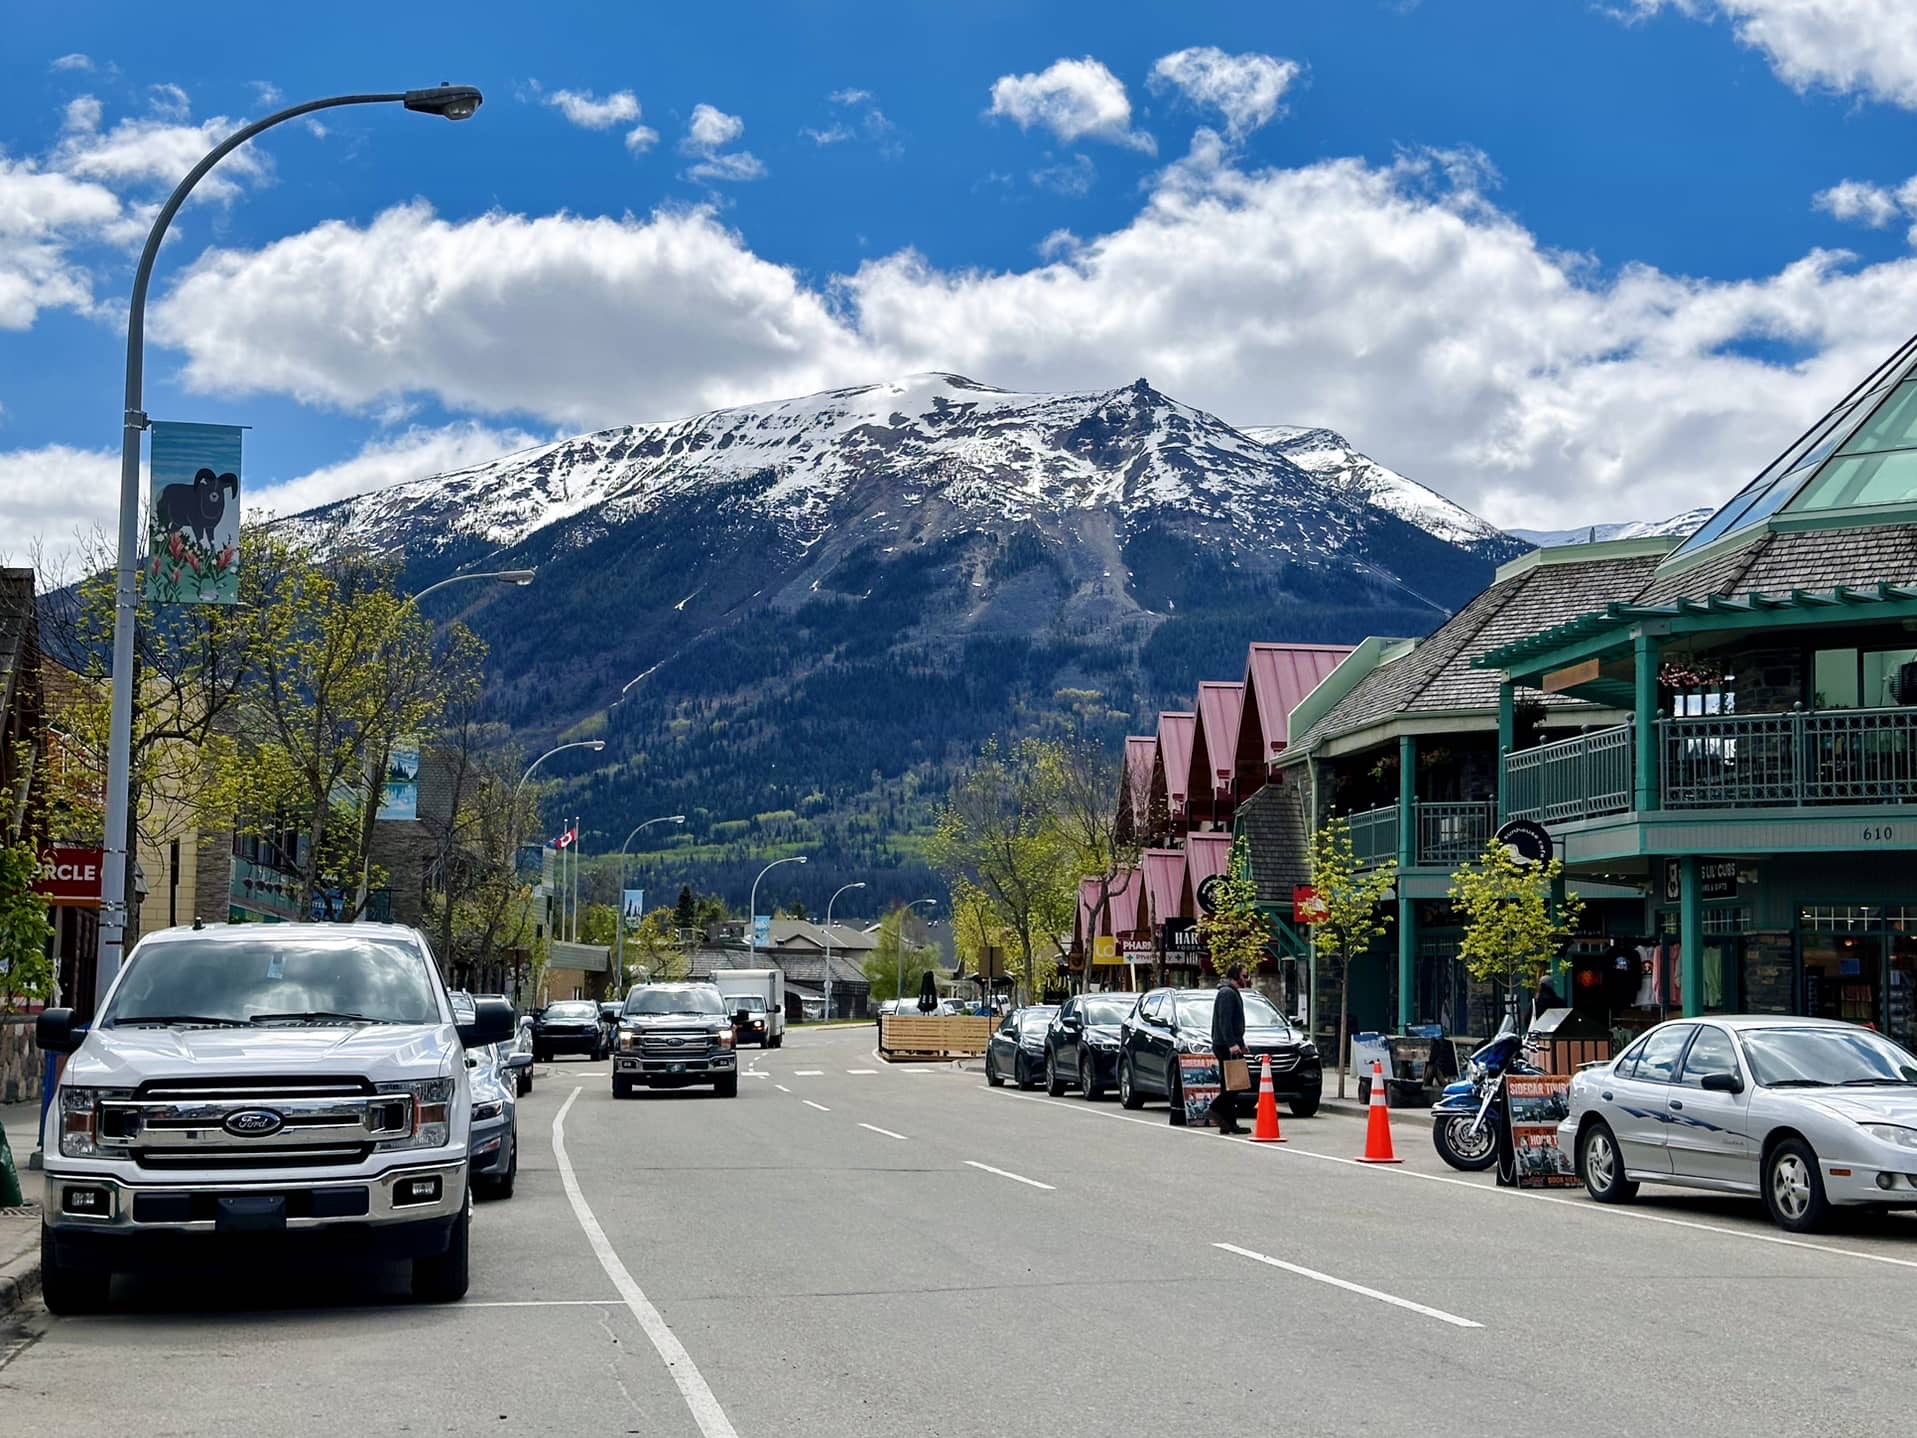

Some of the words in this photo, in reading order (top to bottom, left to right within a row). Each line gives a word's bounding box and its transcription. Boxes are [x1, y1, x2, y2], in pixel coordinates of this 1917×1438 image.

[1863, 826, 1893, 841] 610
[1175, 932, 1199, 945] HAR
[1122, 940, 1154, 951] PHARM
[1509, 1082, 1544, 1095] SIDECAR
[238, 1115, 268, 1128] Ford
